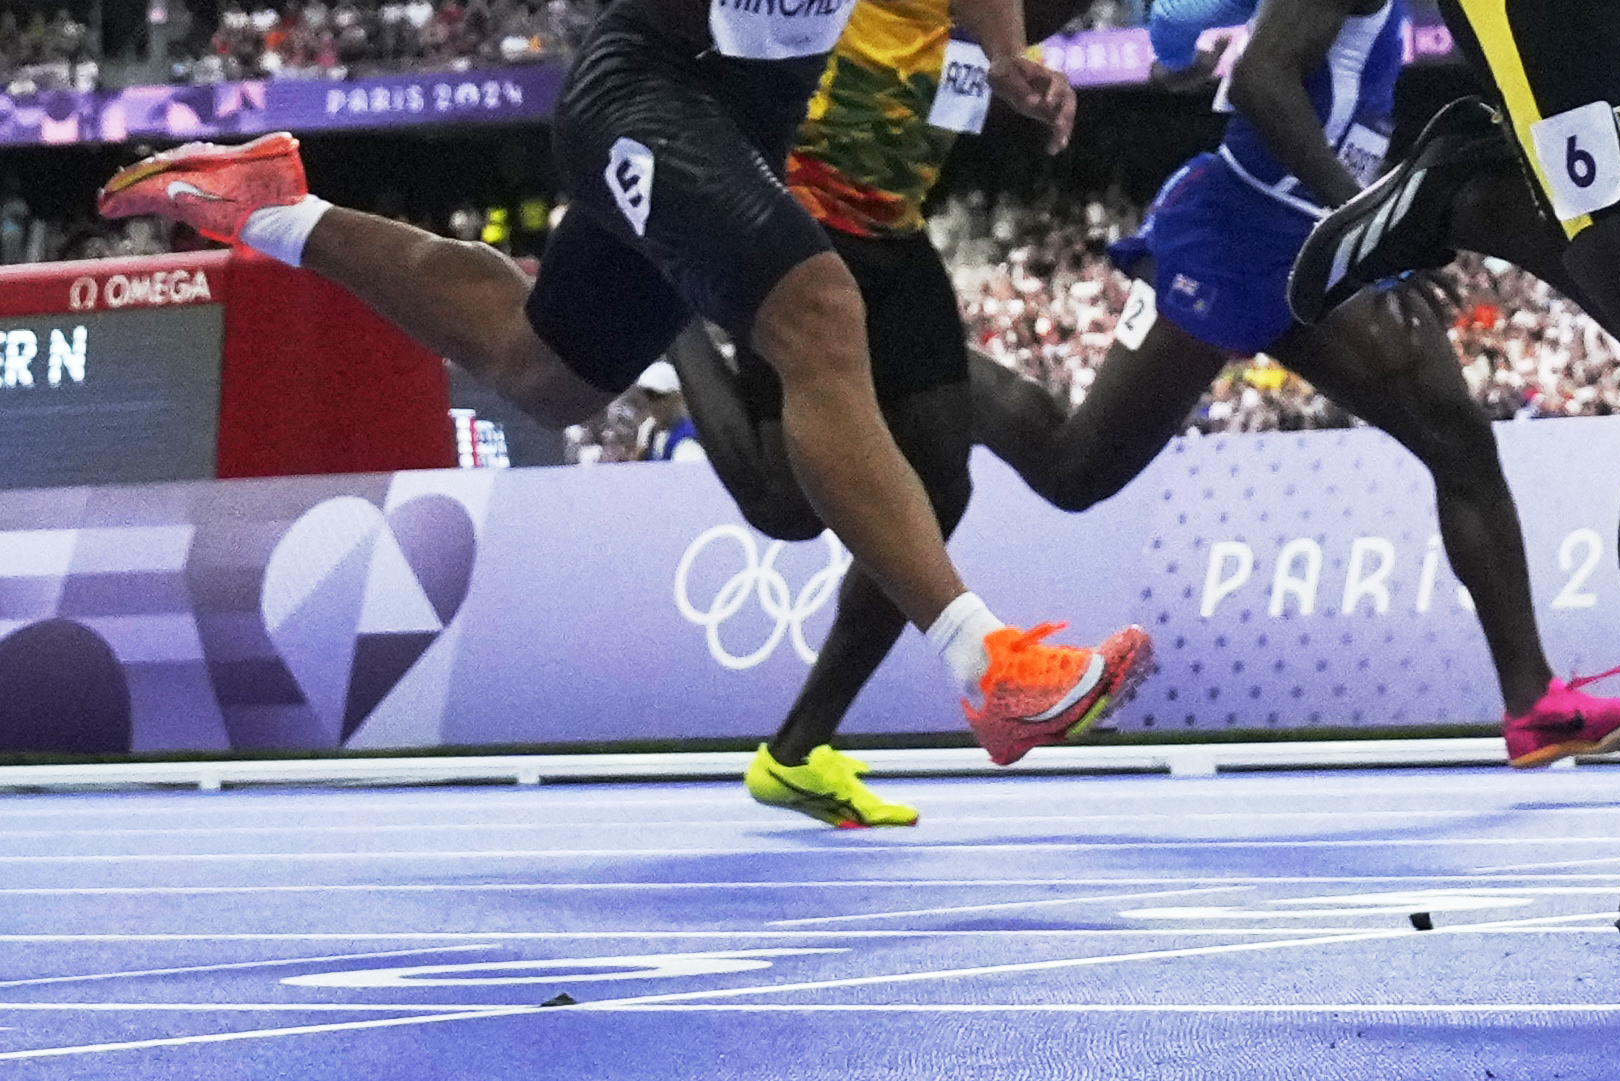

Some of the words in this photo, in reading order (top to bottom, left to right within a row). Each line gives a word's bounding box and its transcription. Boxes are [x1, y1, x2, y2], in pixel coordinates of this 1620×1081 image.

[326, 82, 425, 115] PARIS
[432, 80, 524, 113] 2024
[1566, 134, 1597, 188] 6
[103, 269, 212, 308] OMEGA
[1125, 298, 1145, 332] 2
[1200, 536, 1476, 618] PARI
